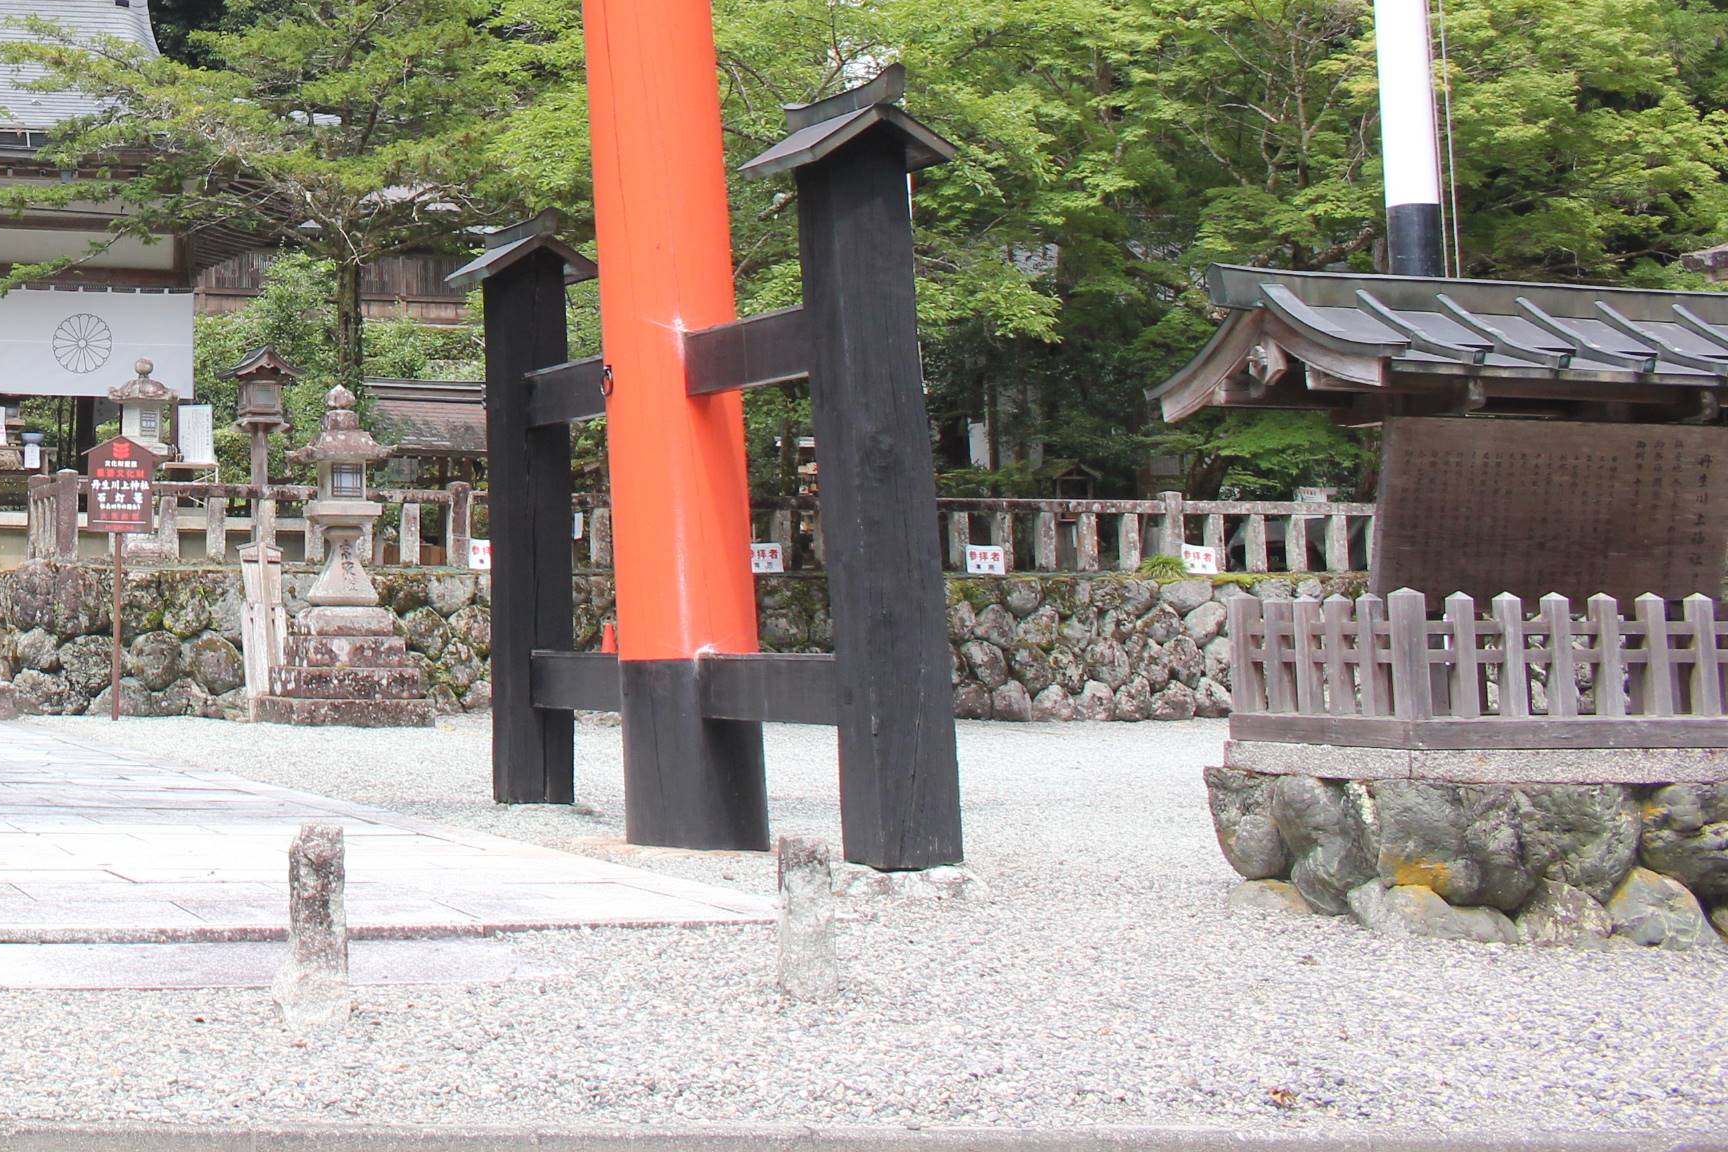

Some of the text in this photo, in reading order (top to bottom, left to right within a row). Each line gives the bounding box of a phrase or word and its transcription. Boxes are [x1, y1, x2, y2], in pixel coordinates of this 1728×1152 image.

[91, 479, 150, 490] 丹生川上神社
[968, 550, 1001, 562] 参拝者
